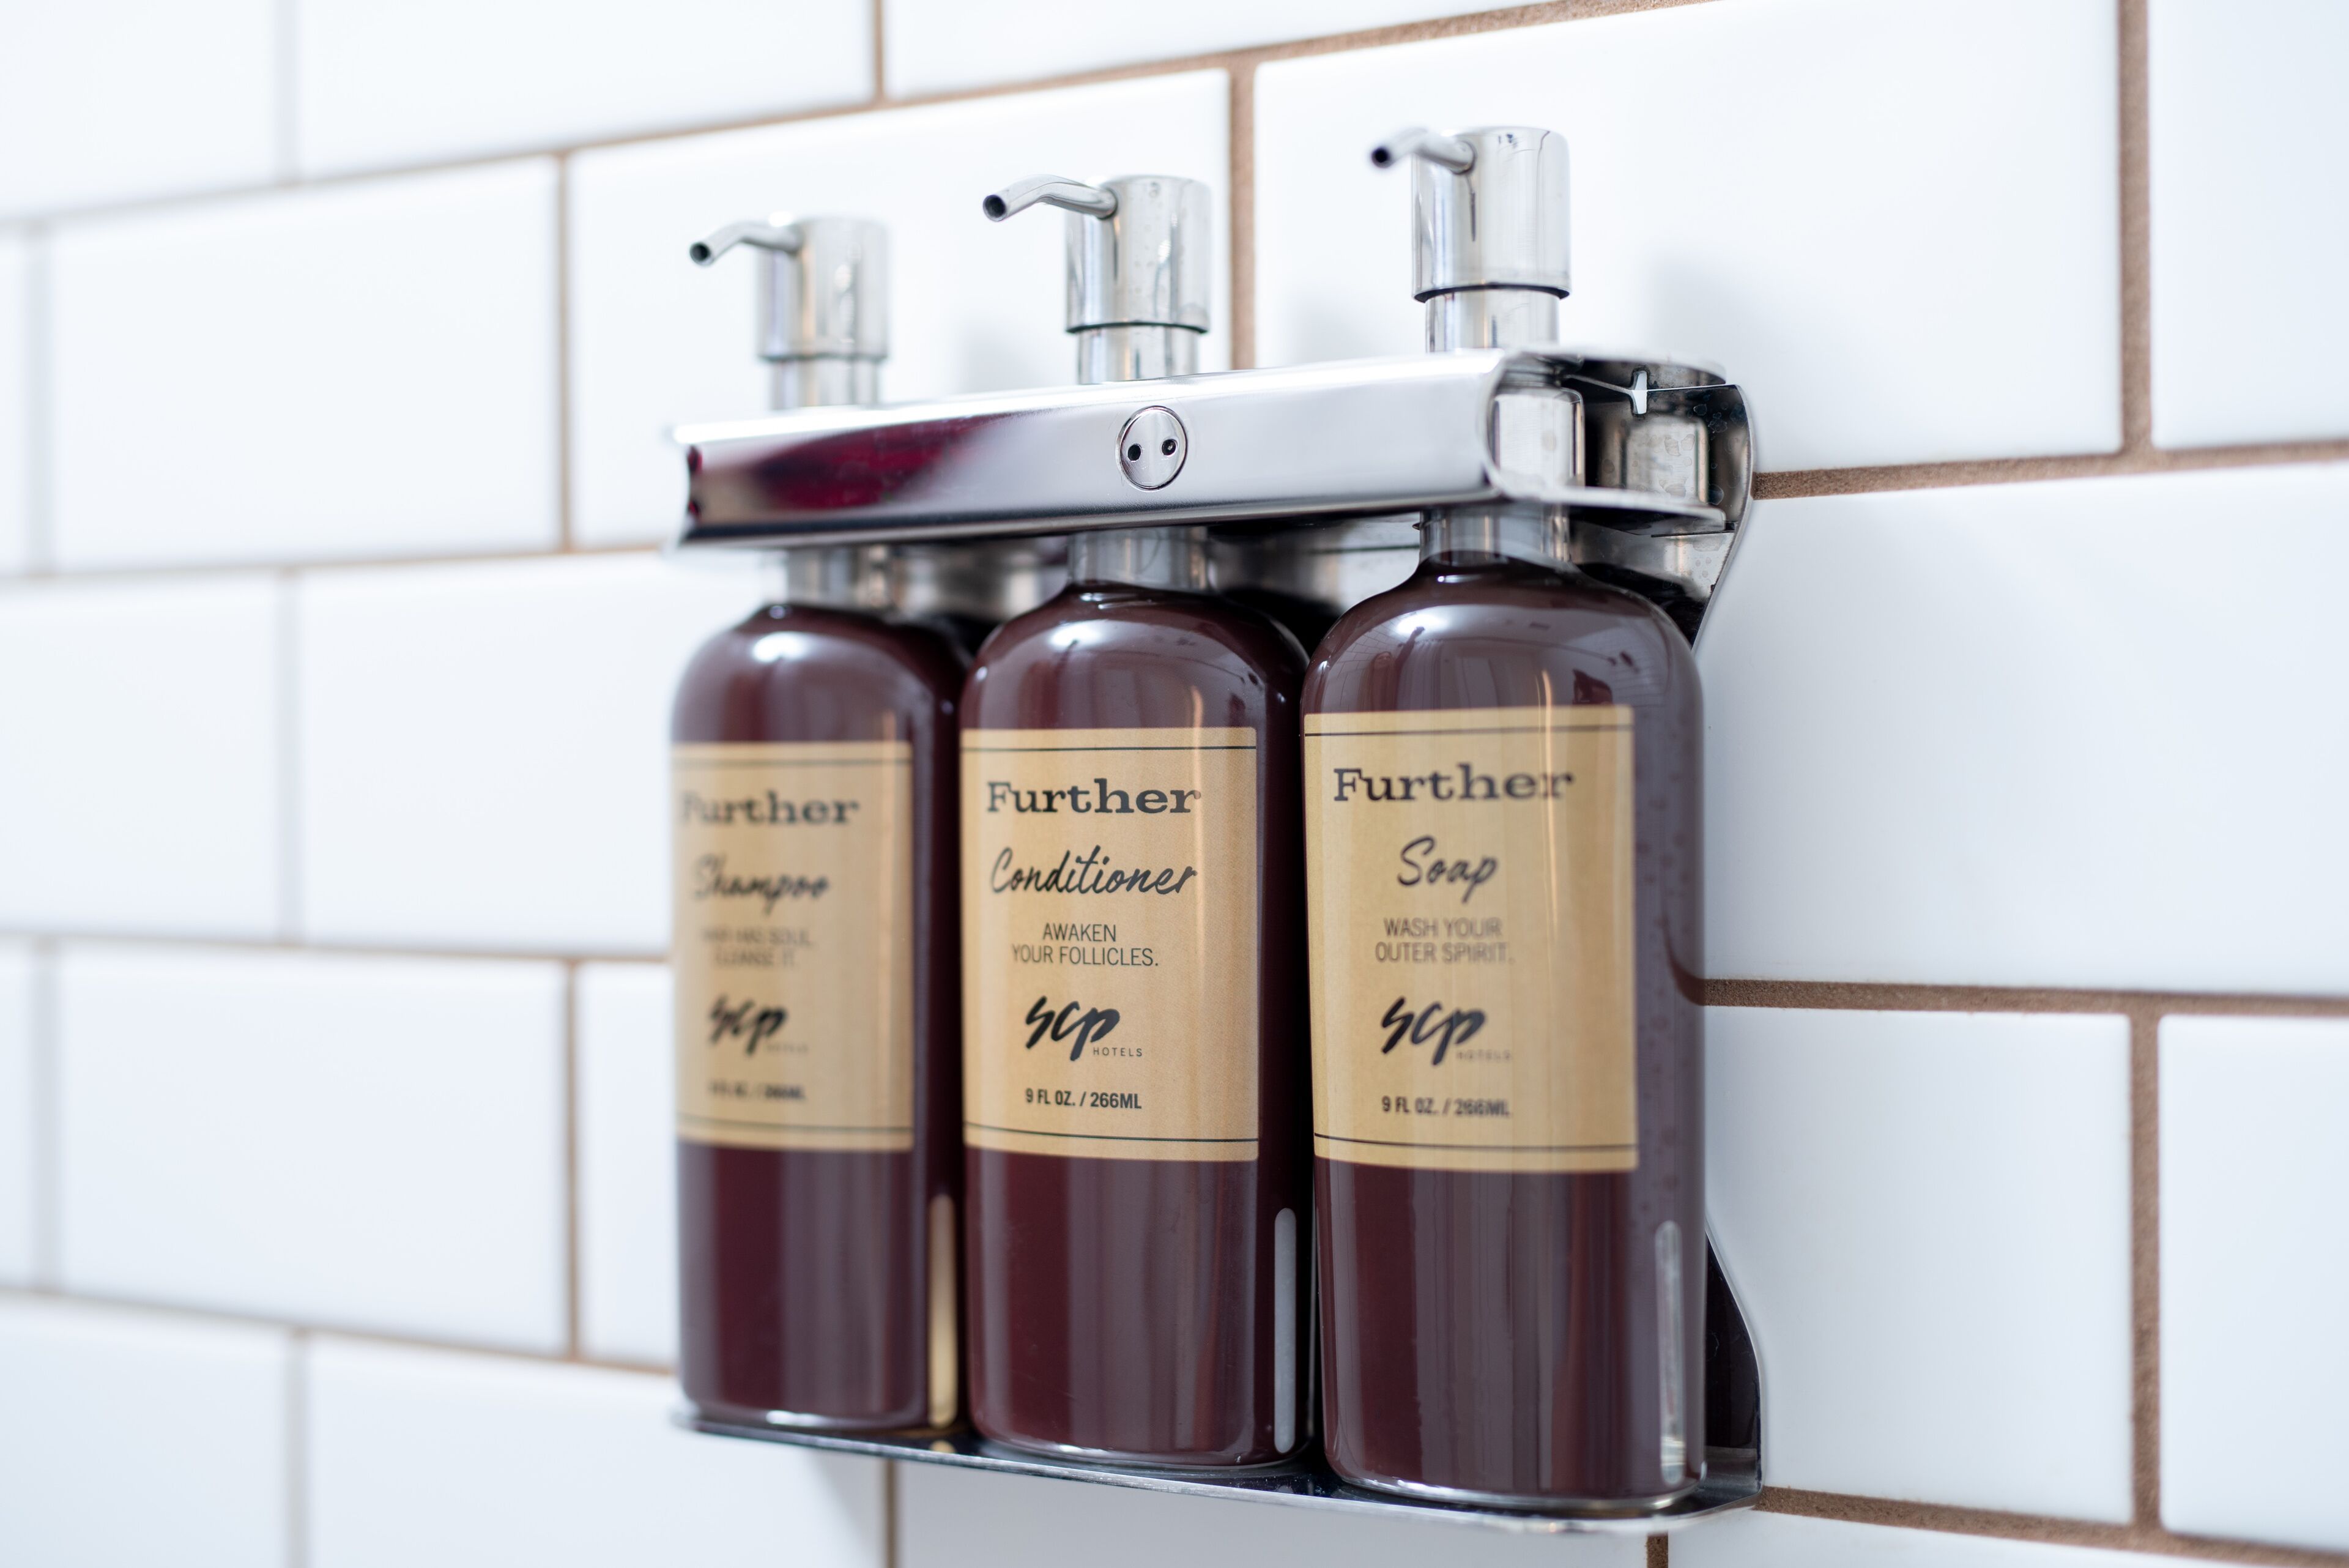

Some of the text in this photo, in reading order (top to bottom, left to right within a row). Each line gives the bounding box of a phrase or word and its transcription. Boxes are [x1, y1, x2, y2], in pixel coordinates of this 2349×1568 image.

[987, 778, 1201, 814] Further
[1333, 762, 1575, 802] Further
[679, 790, 860, 826] Further
[693, 850, 831, 915] Shampoo
[990, 844, 1198, 895] Conditioner
[1397, 834, 1498, 904] Soap
[1043, 922, 1117, 943] AWAKEN
[1383, 917, 1503, 938] WASH YOUR
[1012, 944, 1159, 967] YOUR FOLLICLES.
[1375, 941, 1436, 963] OUTER
[1025, 995, 1121, 1061] scp
[1380, 996, 1487, 1066] scp
[1093, 1047, 1143, 1057] HOTELS
[1025, 1088, 1142, 1110] 9 FL OZ. / 266ML
[1381, 1095, 1391, 1112] 9
[1395, 1096, 1410, 1113] FL
